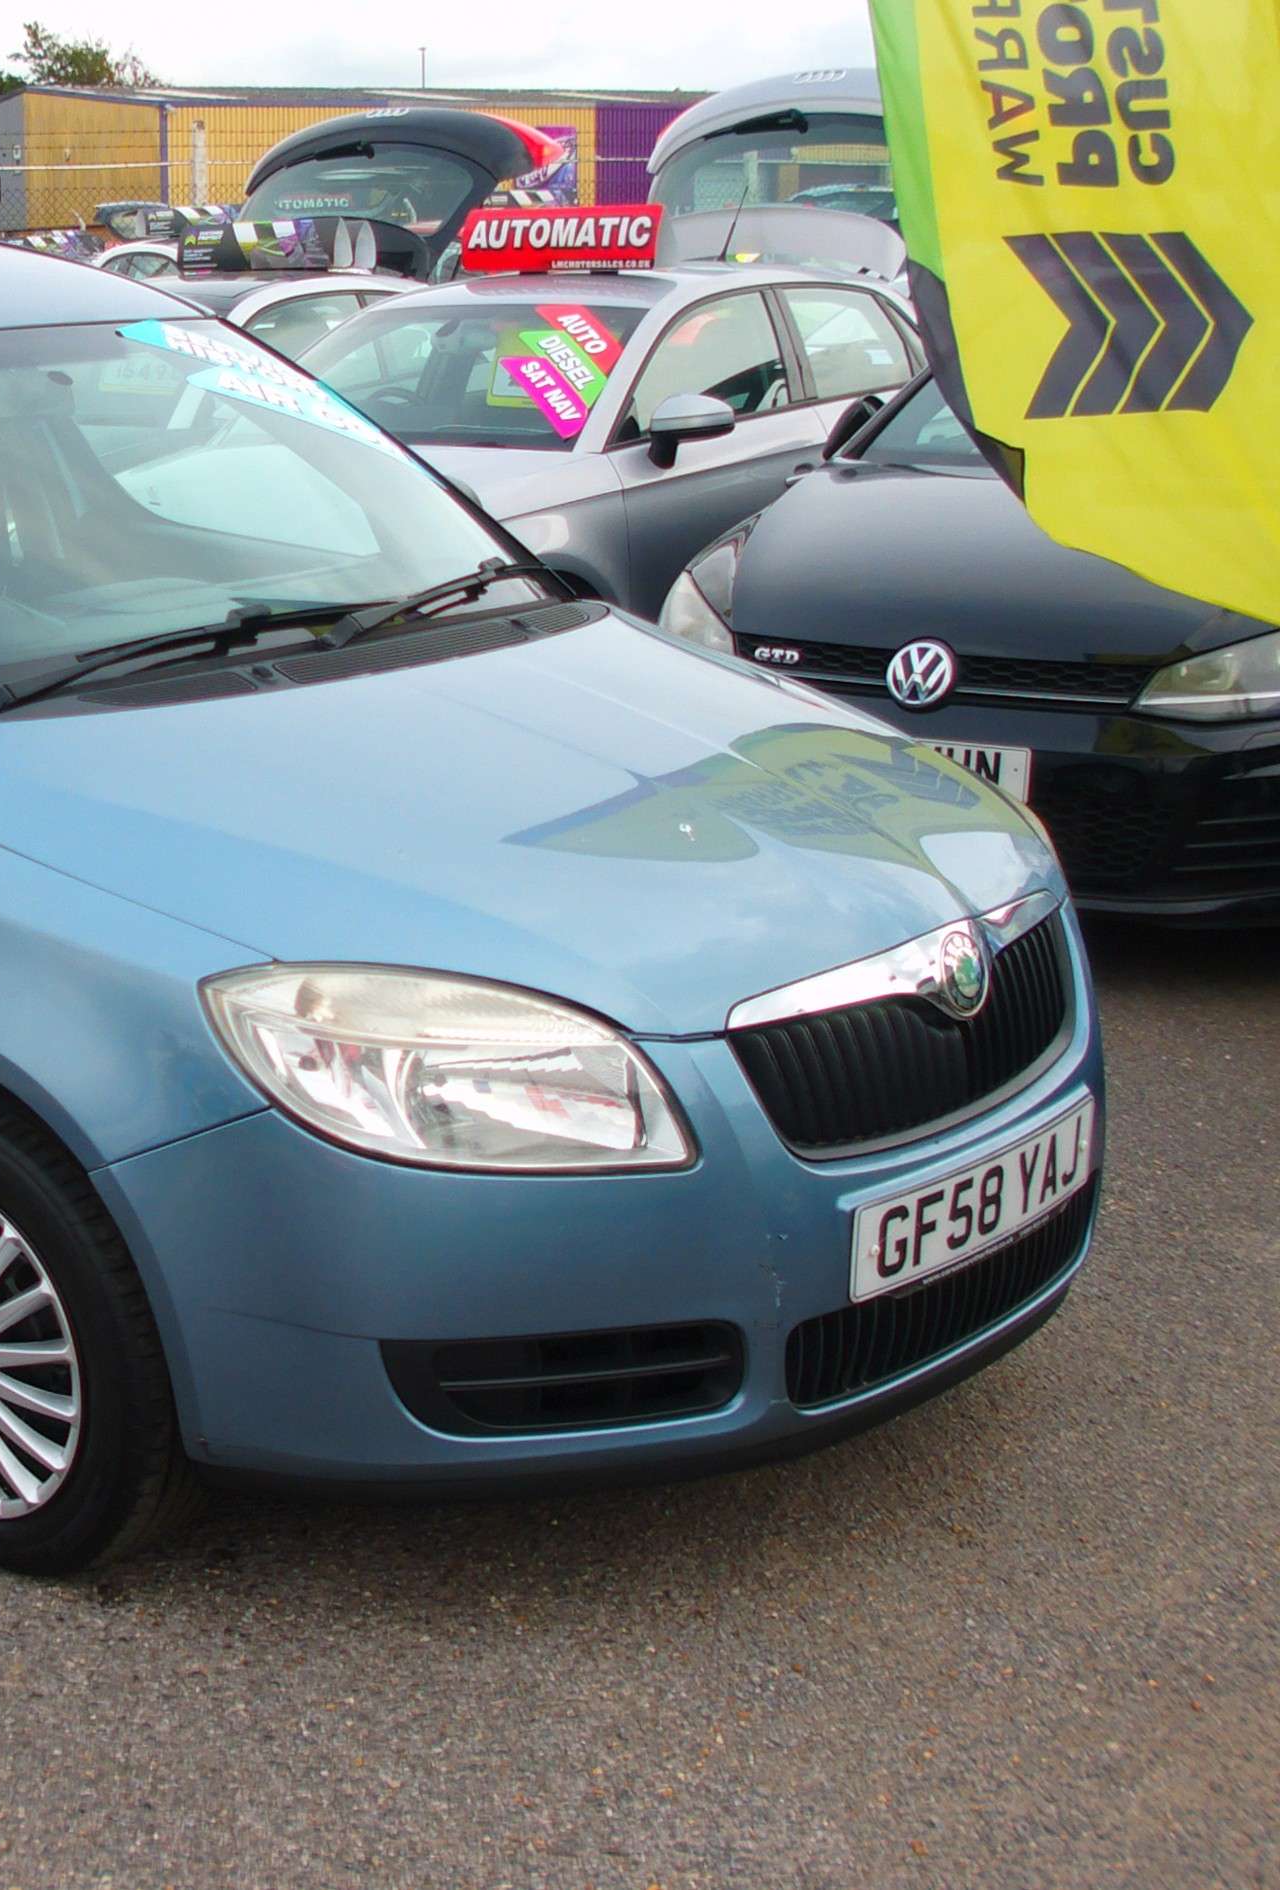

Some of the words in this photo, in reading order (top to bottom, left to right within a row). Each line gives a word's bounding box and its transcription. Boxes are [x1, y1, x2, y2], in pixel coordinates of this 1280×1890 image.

[468, 215, 652, 250] AUTOMATIC
[556, 313, 608, 354] AUTO
[537, 335, 596, 391] DIESEL
[520, 361, 557, 389] SAT
[542, 387, 582, 420] NAV
[754, 647, 799, 664] GTD
[877, 1164, 1004, 1278] GF58
[1019, 1115, 1082, 1214] YAJ
